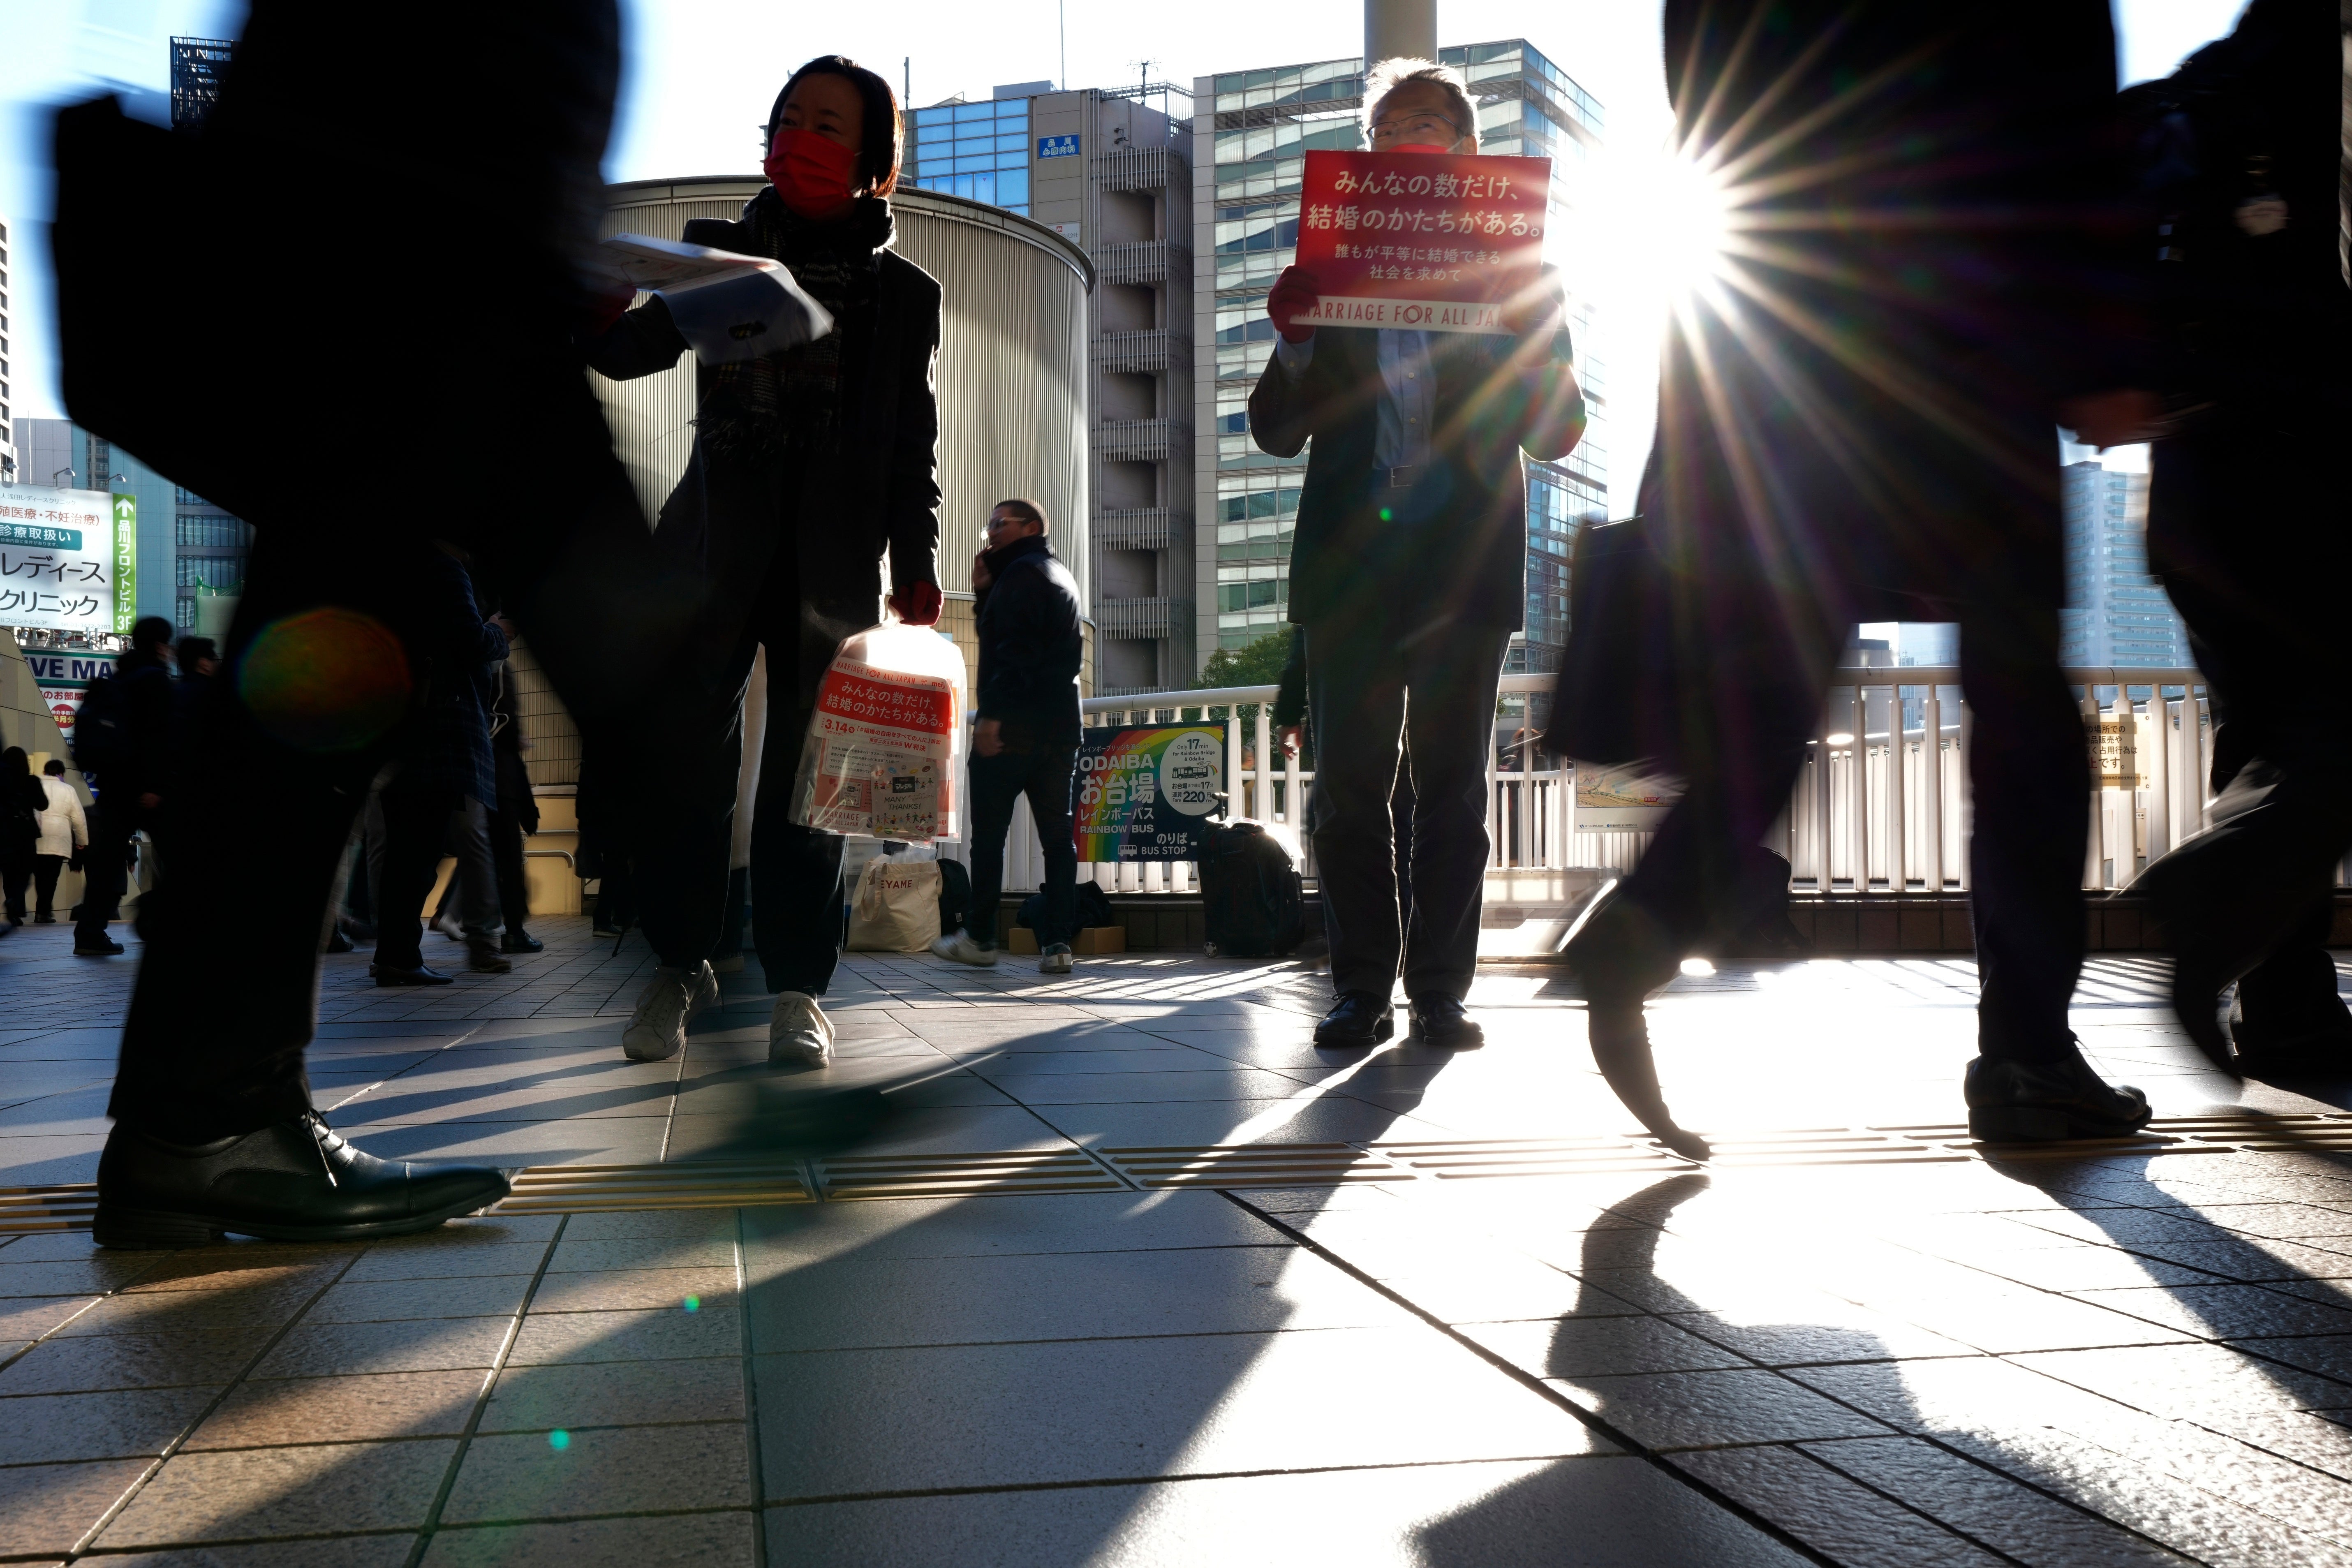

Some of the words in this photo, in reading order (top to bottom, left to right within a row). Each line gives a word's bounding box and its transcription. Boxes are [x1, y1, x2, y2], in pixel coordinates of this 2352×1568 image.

[1043, 145, 1075, 155] 心療内科
[1334, 171, 1518, 200] みんなの数だけ、
[1307, 204, 1540, 238] 結婚のかたちがある。
[1335, 243, 1501, 265] 誰もが平等に結婚できる
[1369, 264, 1460, 282] 社会を求めて
[1394, 305, 1433, 324] FOR
[1440, 308, 1468, 325] ALL
[0, 525, 71, 542] 診療取扱い
[2, 553, 105, 583] レディース
[0, 589, 98, 616] クリニック
[836, 661, 864, 674] MARRIAGE
[866, 669, 881, 678] FOR
[896, 675, 916, 684] JAPAN
[932, 681, 946, 689] meiji
[842, 681, 934, 710] みんなの数だけ、
[826, 693, 944, 727] 結婚のかたちがある。
[1187, 739, 1200, 749] 17
[1080, 754, 1154, 772] ODAIBA
[1080, 773, 1155, 805] お台場
[1183, 791, 1205, 803] 220
[824, 810, 860, 821] MARRIAGE
[1080, 807, 1154, 821] レインボーバス
[1080, 825, 1127, 834] RAINBOW
[1131, 824, 1154, 833] BUS
[1156, 832, 1187, 845] のりば
[1162, 846, 1187, 855] STOP
